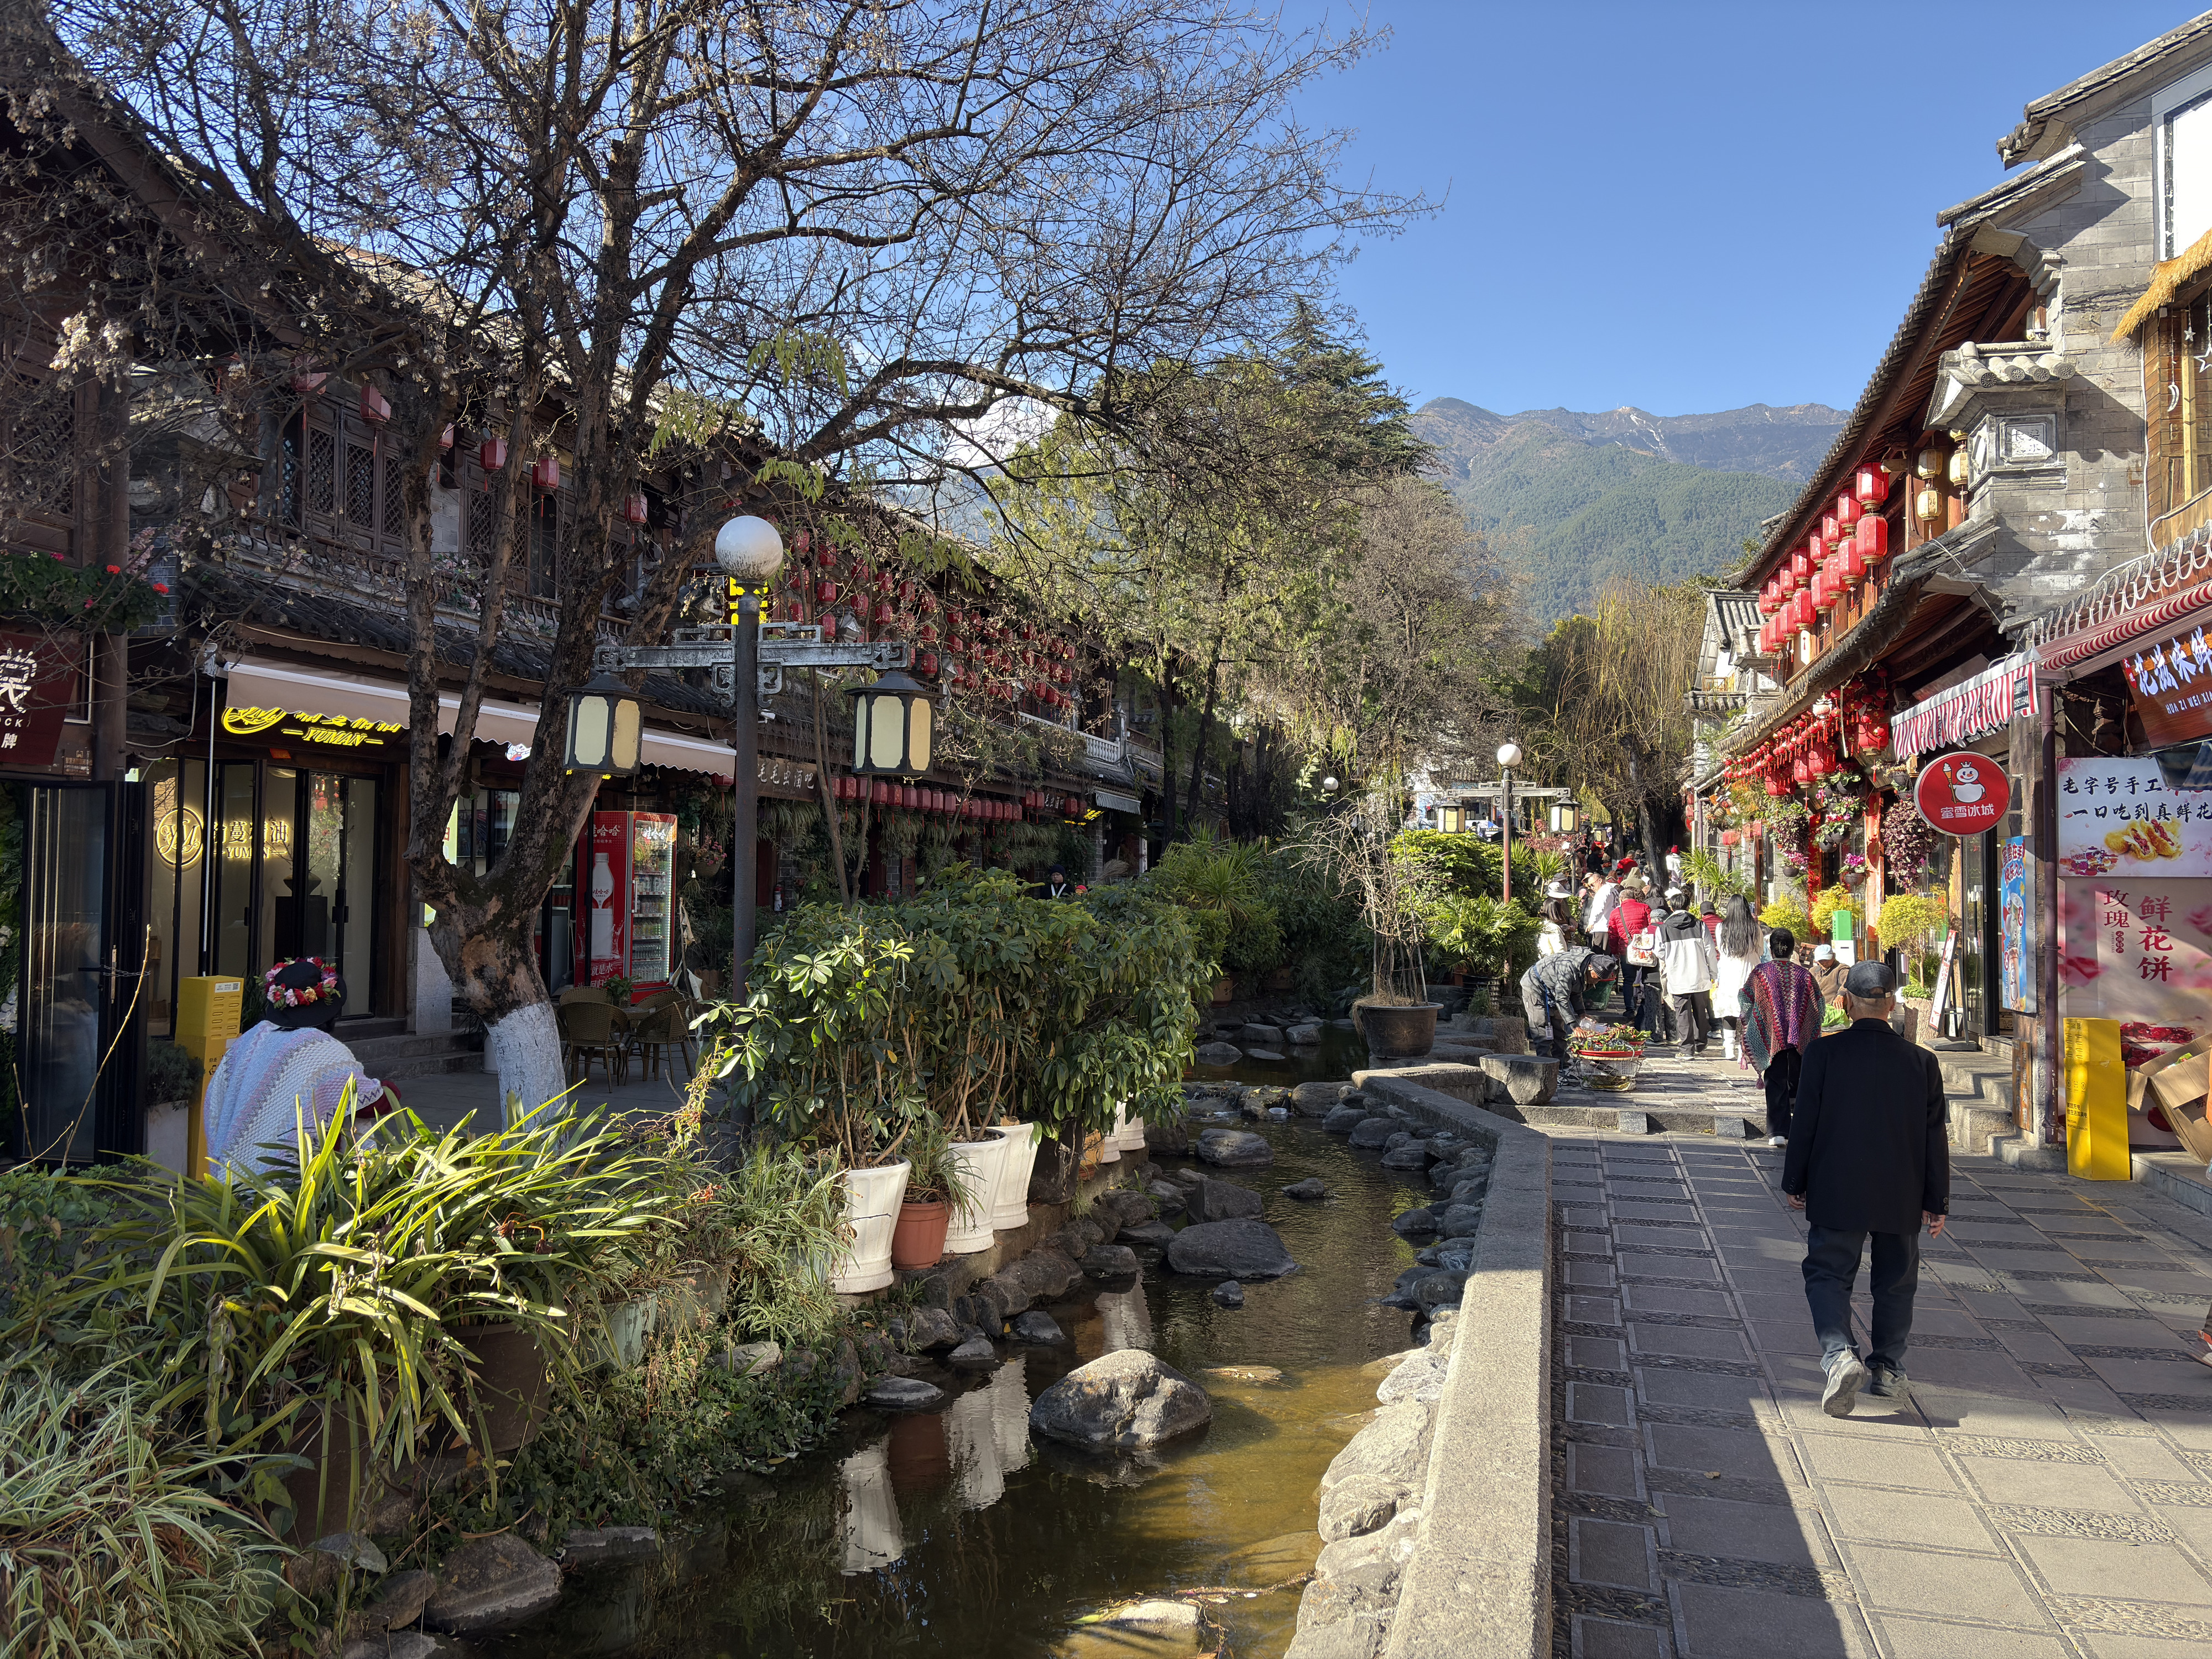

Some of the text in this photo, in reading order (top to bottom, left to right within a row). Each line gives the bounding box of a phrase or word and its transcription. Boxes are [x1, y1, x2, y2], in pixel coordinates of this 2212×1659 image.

[2166, 702, 2179, 714] HUA
[2178, 699, 2188, 711] ZI
[2187, 694, 2201, 707] WEI
[0, 718, 23, 728] CK
[1, 733, 18, 749] 牌
[304, 727, 368, 747] YUMAN
[758, 762, 815, 789] 毛毛虫酒吧
[2063, 776, 2162, 795] 老字号手工
[1940, 803, 1995, 819] 蜜雪冰城
[2072, 802, 2212, 823] 一口吃到真鲜花
[643, 826, 666, 840] 娃哈哈
[227, 847, 271, 859] YUMN
[2004, 862, 2023, 886] 快乐久久
[2104, 890, 2130, 928] 玫瑰
[2136, 895, 2174, 982] 鲜花饼
